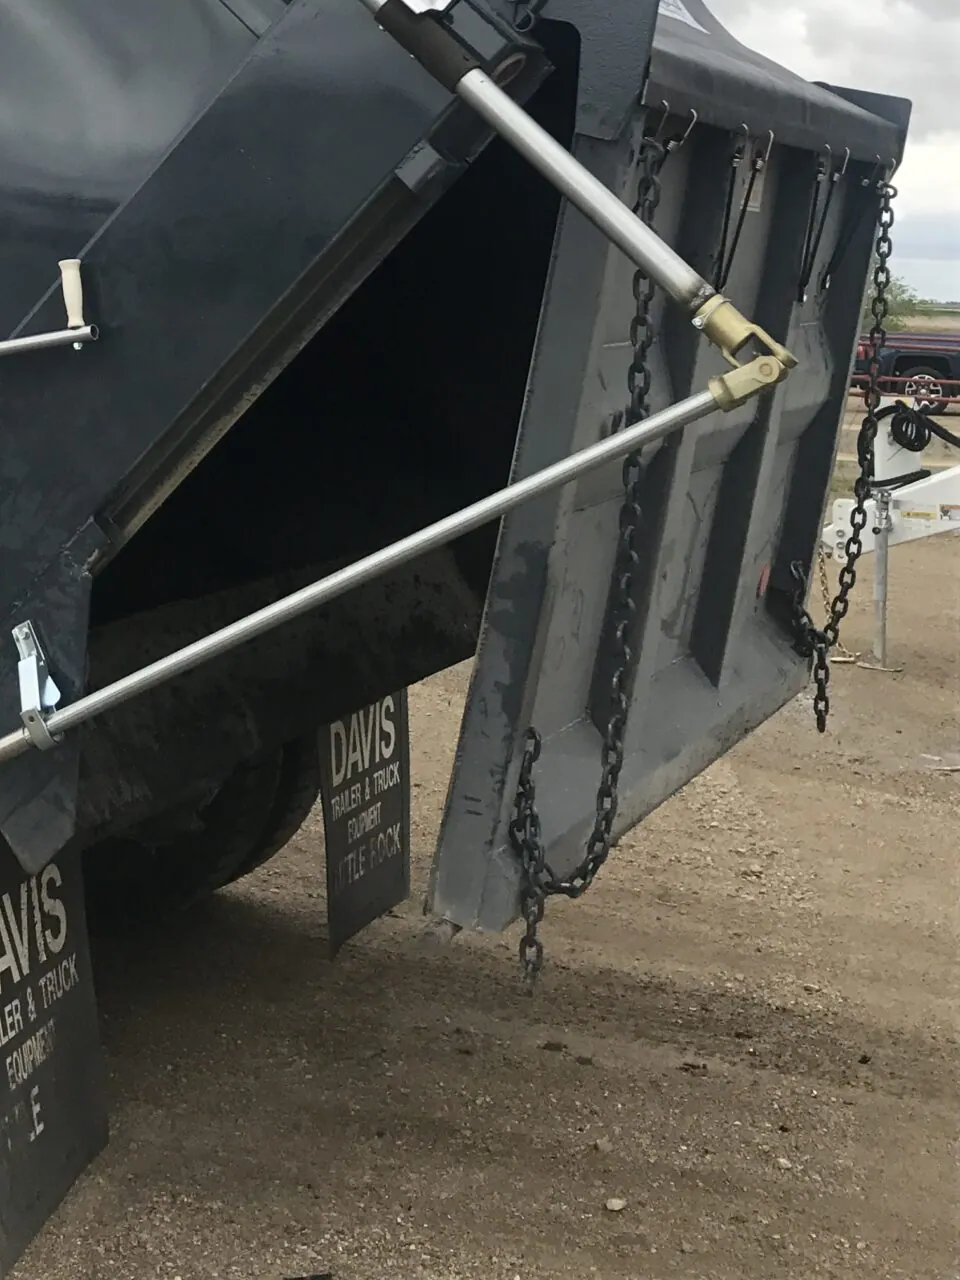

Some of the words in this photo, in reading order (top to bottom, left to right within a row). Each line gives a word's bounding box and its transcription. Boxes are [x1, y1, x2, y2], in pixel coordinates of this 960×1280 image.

[330, 696, 395, 787] DAVIS
[331, 783, 362, 821] TRAILER
[365, 777, 370, 800] &
[373, 761, 401, 795] TRUCK
[26, 986, 37, 1021] &
[39, 953, 79, 1008] TRUCK
